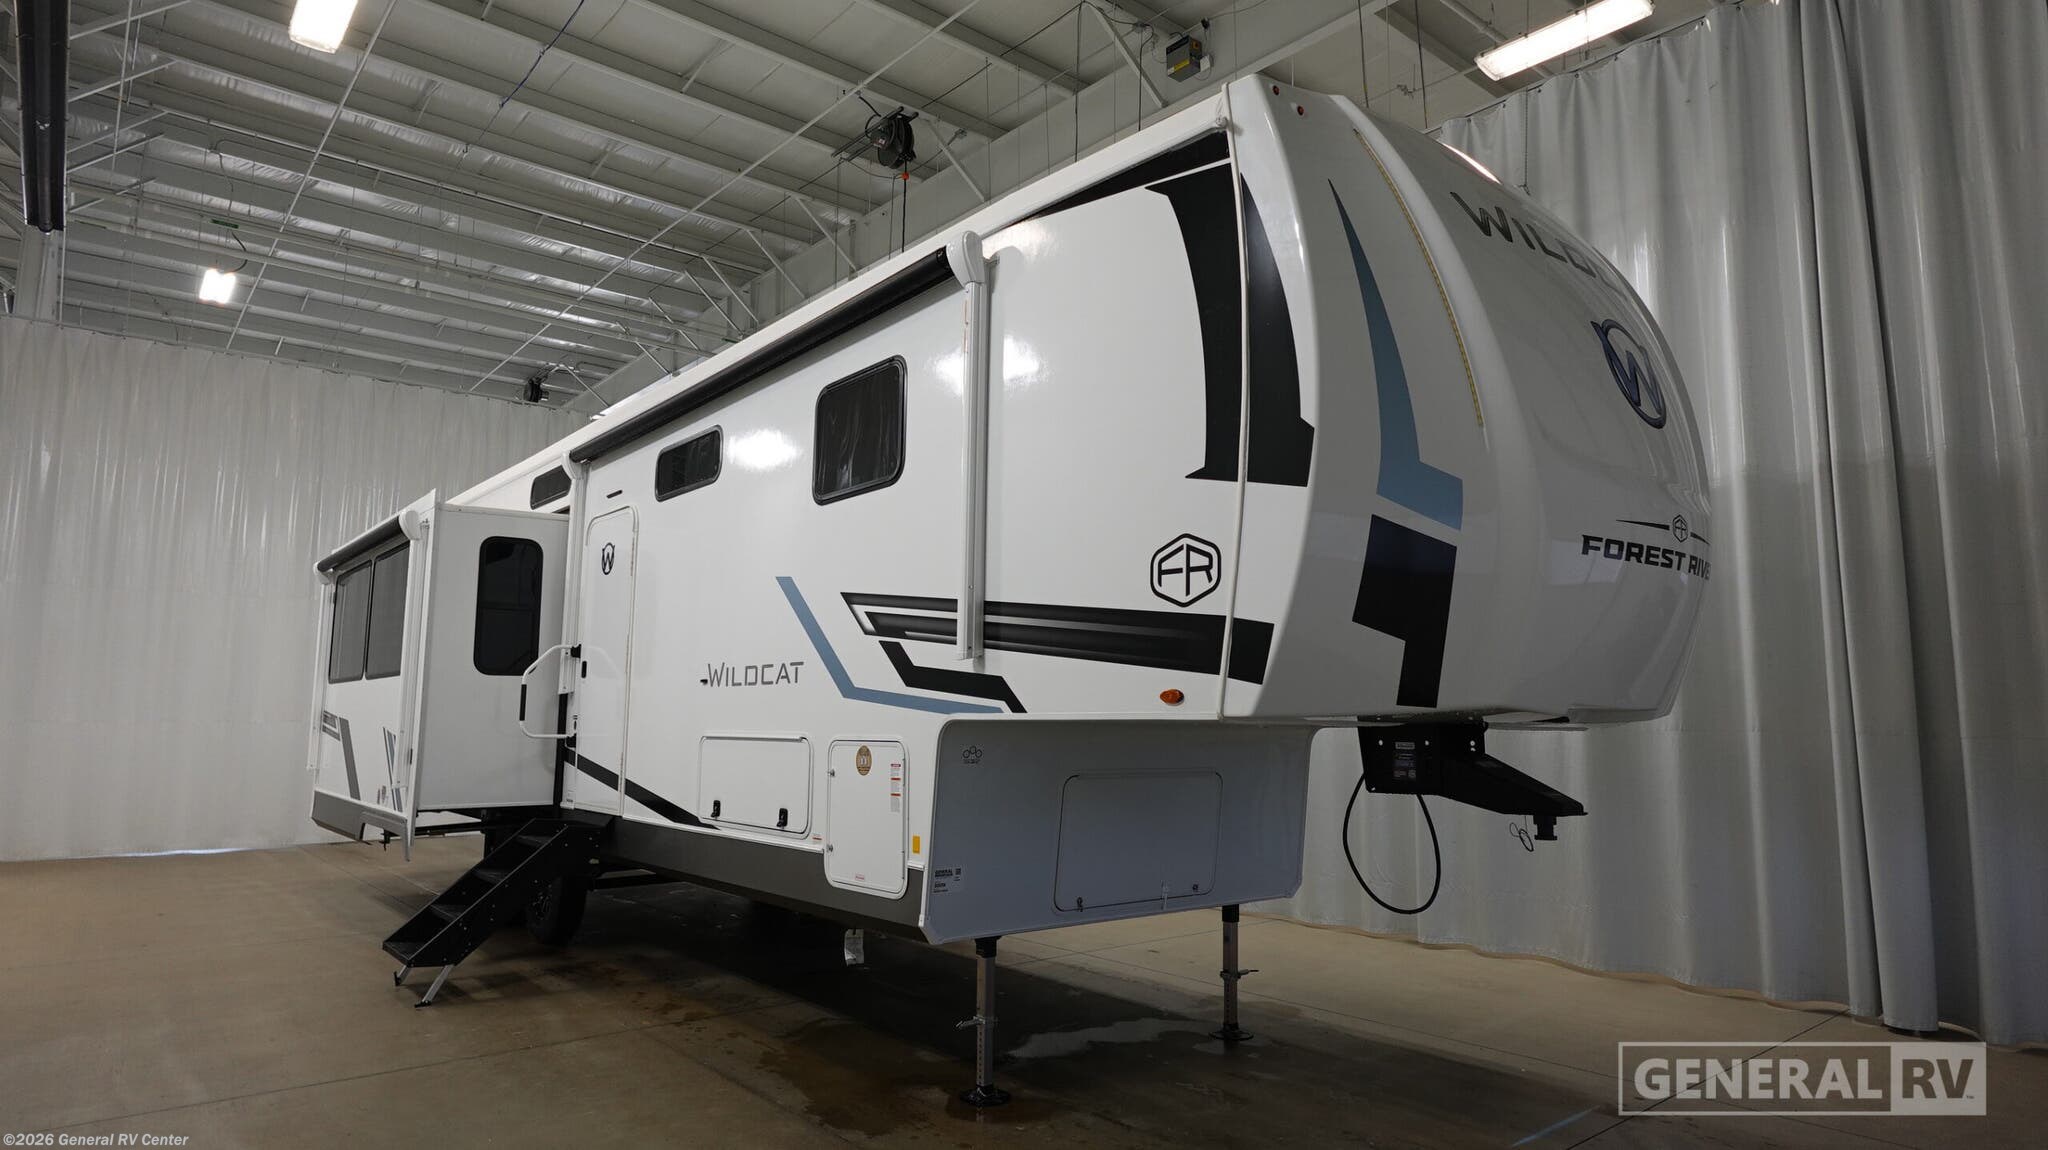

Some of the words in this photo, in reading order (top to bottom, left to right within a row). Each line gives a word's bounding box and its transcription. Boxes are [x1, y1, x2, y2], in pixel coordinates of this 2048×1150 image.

[1158, 543, 1213, 597] FR
[1582, 534, 1686, 571] FOREST
[1688, 555, 1711, 580] RIVE
[708, 662, 804, 687] WILDCAT
